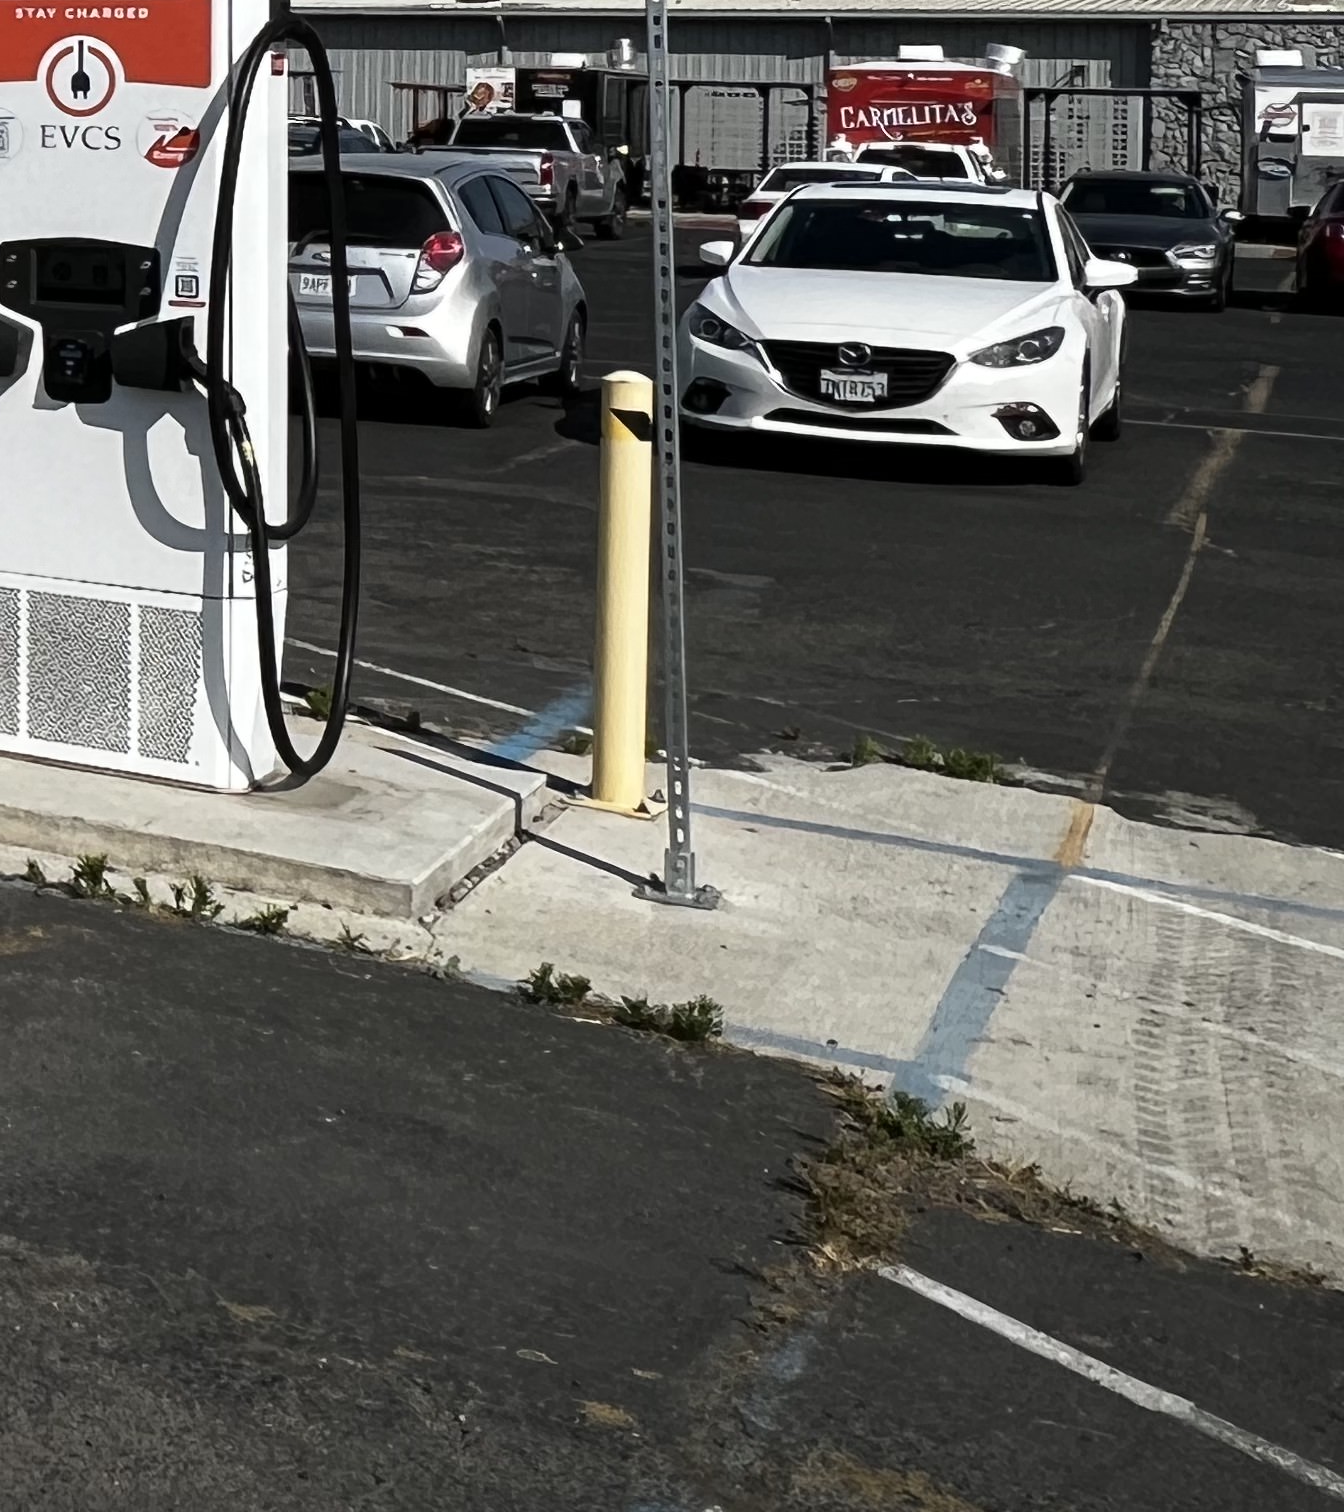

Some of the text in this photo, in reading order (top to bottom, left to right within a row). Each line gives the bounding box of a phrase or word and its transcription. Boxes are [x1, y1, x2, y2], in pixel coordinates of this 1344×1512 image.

[15, 7, 149, 19] STAY CHARGED
[840, 101, 977, 140] CARMELITA'S
[40, 124, 121, 150] EVCS
